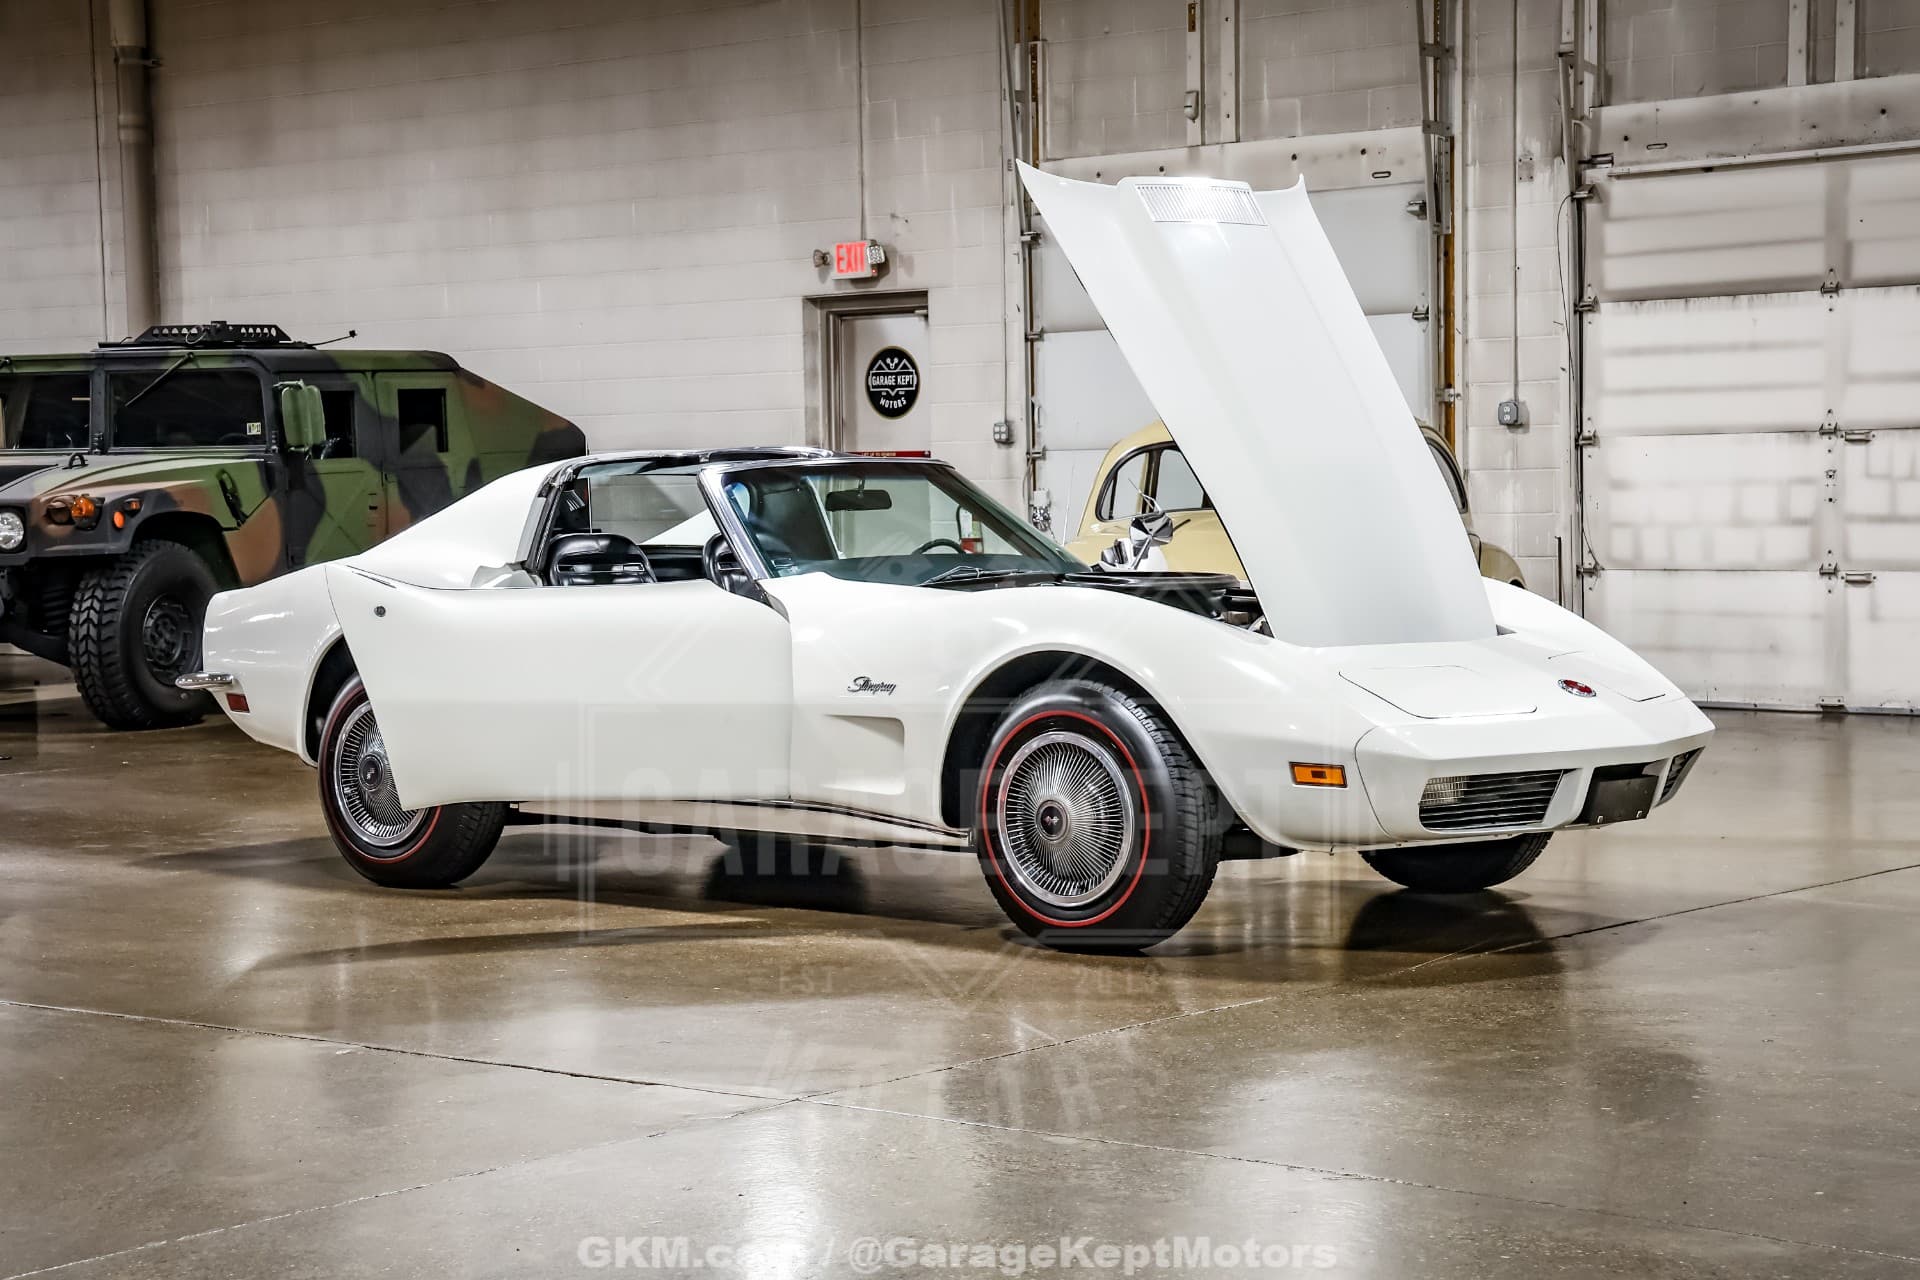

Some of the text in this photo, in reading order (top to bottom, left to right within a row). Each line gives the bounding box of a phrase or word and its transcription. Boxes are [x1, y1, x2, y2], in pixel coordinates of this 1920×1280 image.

[836, 242, 867, 272] EXIT
[872, 375, 913, 386] GARAGE KEPT
[880, 397, 906, 409] MOTORS
